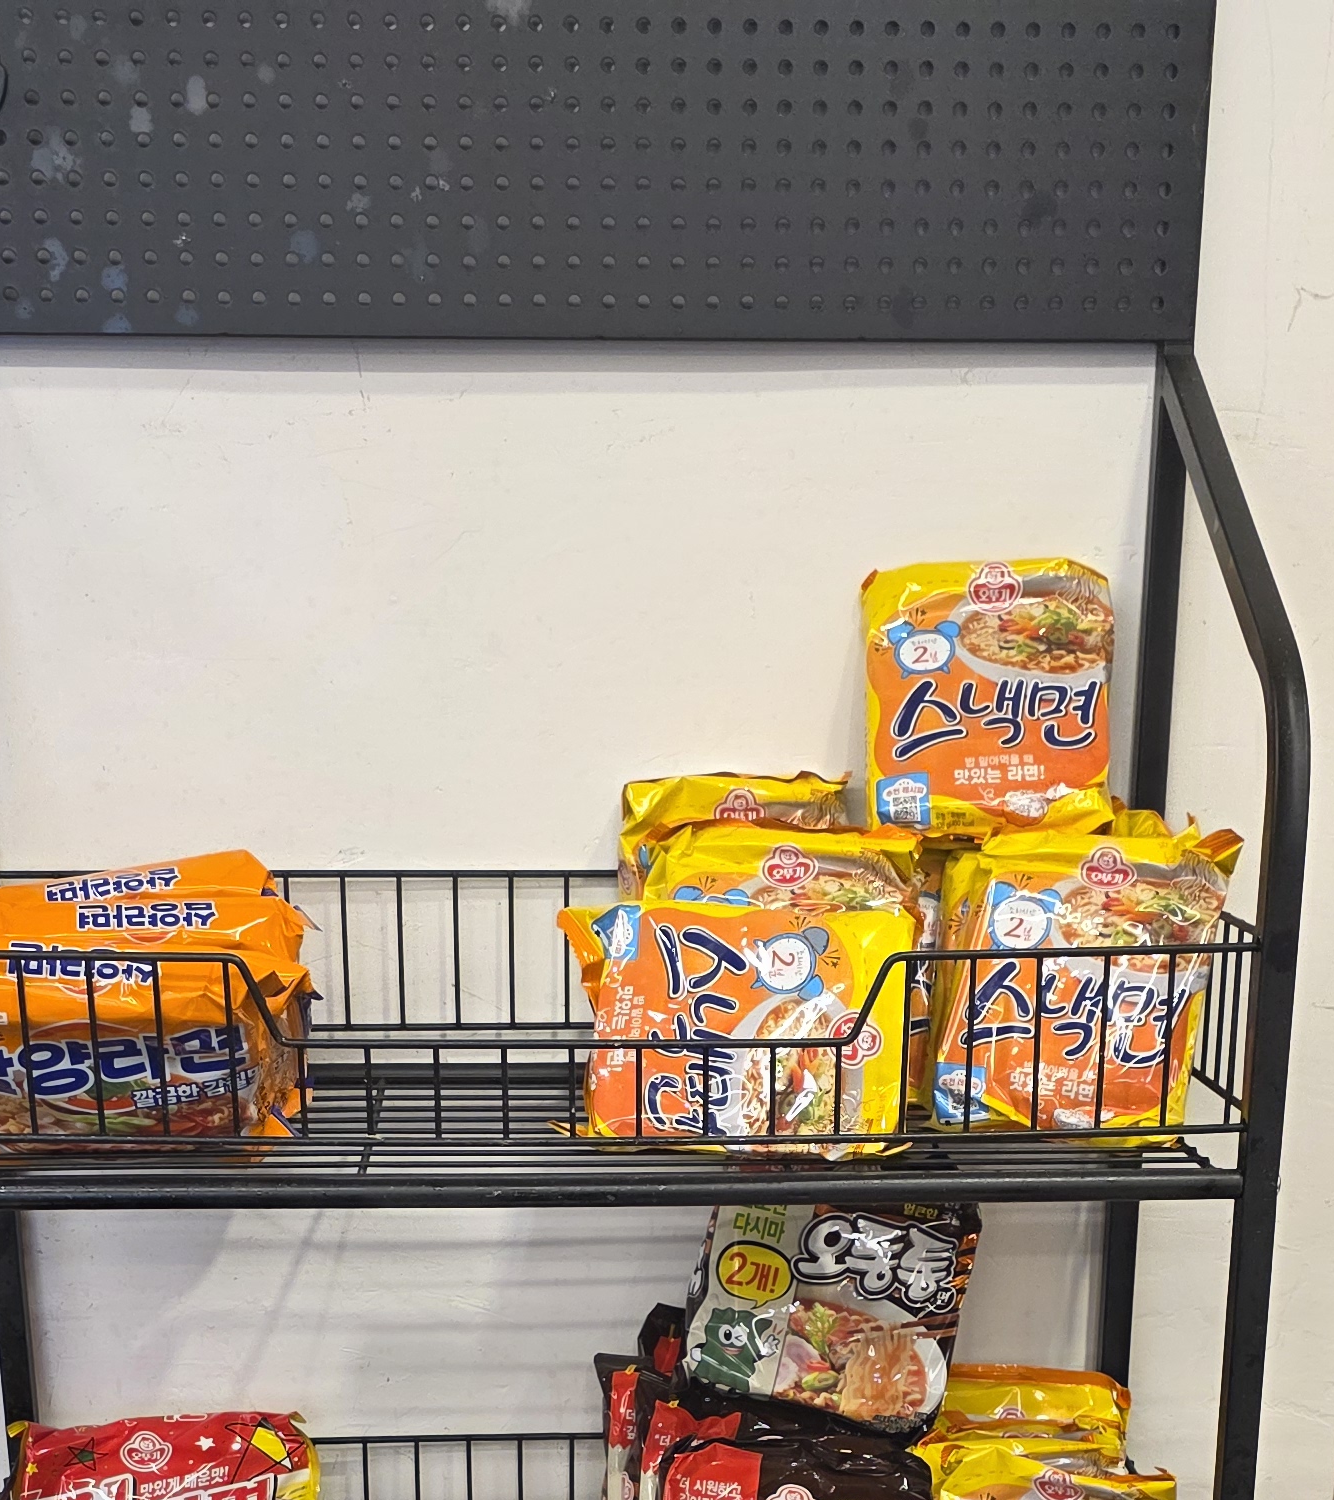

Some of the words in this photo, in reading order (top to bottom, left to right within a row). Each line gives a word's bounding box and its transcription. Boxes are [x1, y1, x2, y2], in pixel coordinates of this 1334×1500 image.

[891, 678, 1101, 761] 스낵면
[954, 768, 1002, 785] 맛있는
[1007, 765, 1046, 781] 라면!
[46, 867, 181, 902] 삼양라면
[77, 902, 217, 930] 삼양라면
[960, 959, 1190, 1068] 스낵면
[732, 1212, 786, 1244] 다시마
[725, 1251, 780, 1294] 2개!
[139, 1479, 180, 1499] 맛있게
